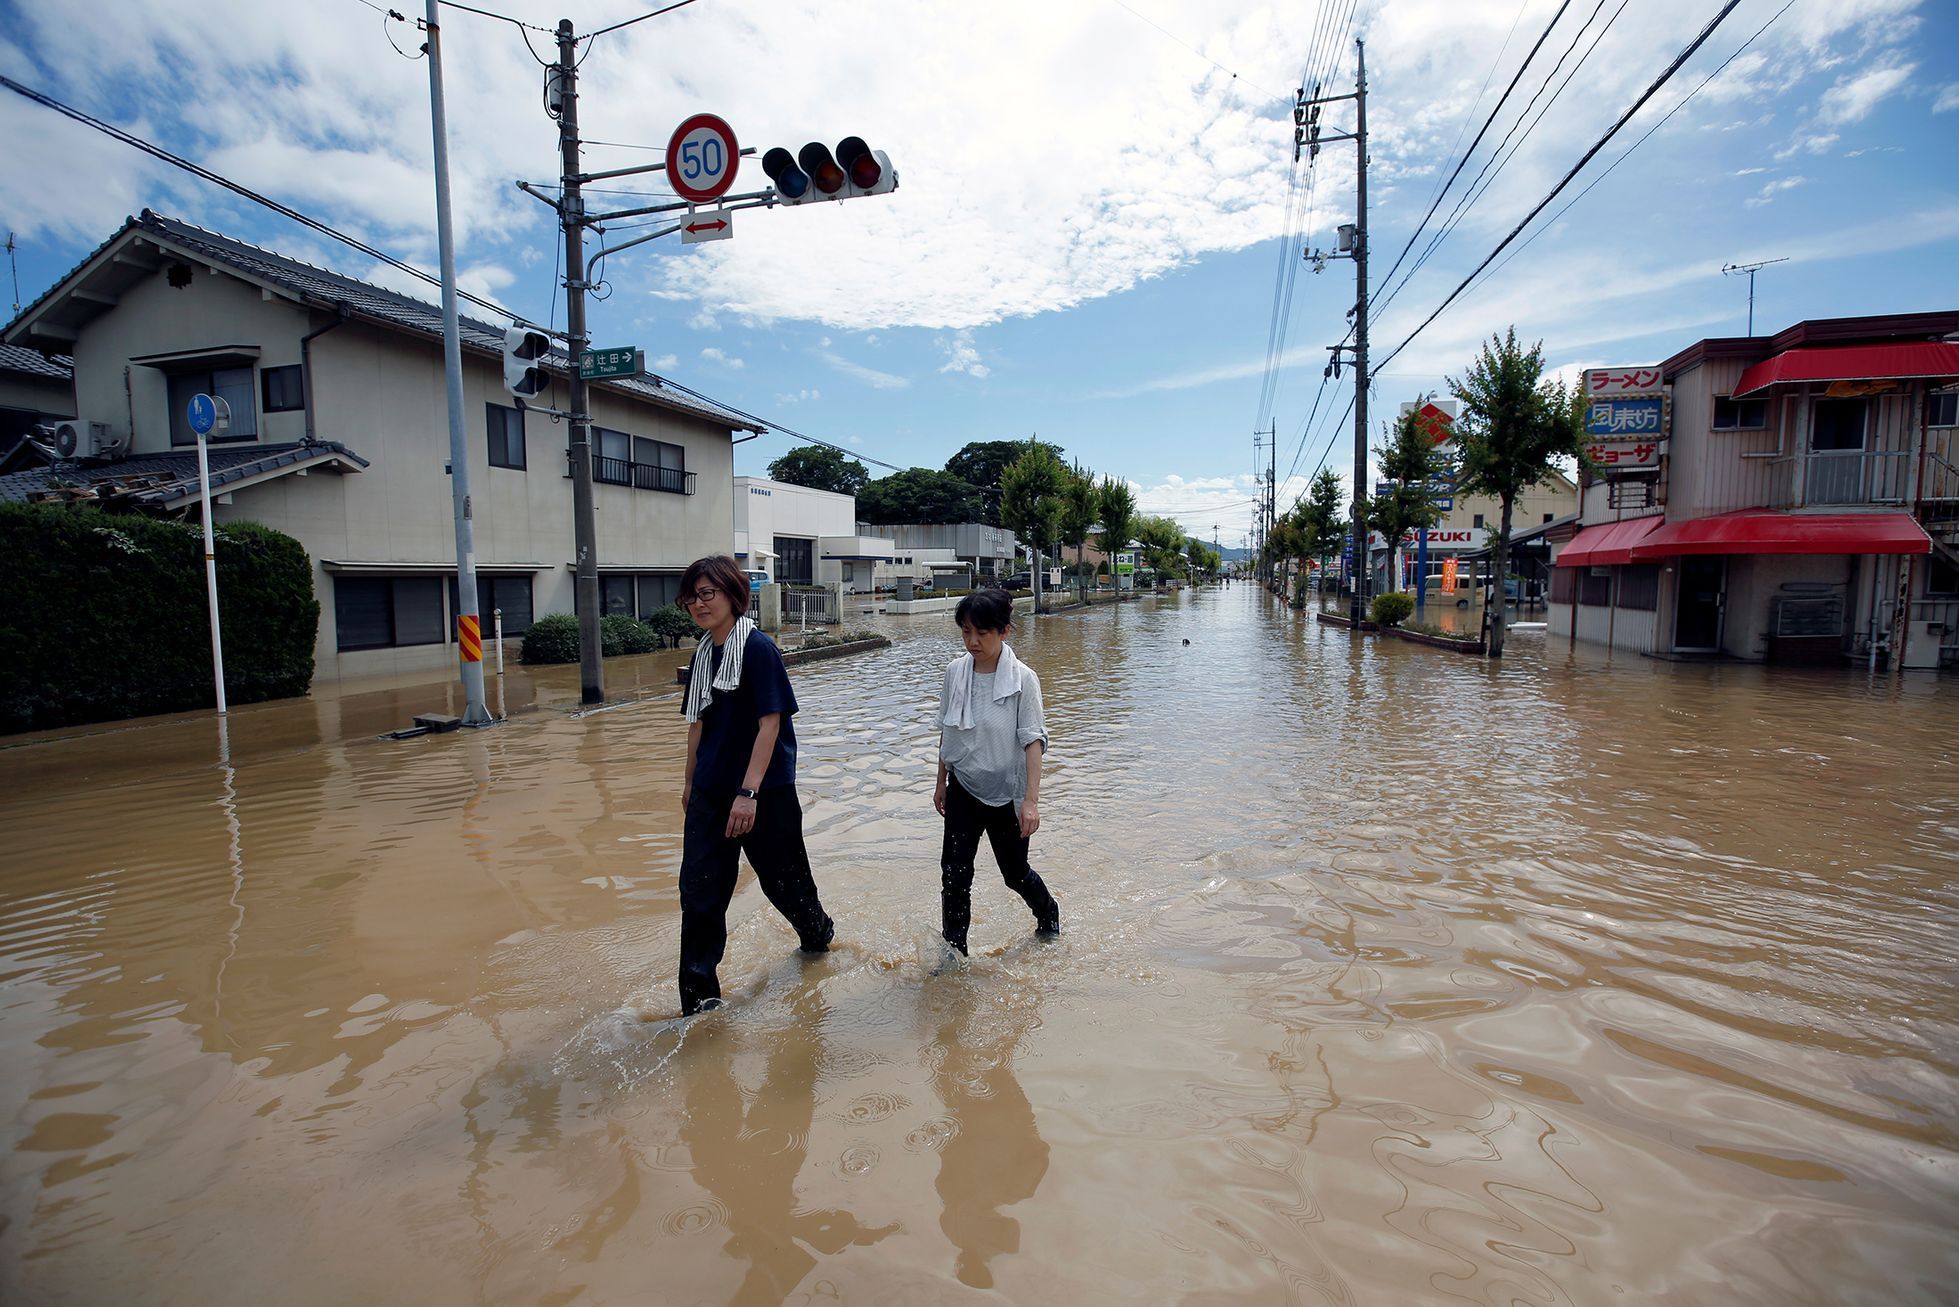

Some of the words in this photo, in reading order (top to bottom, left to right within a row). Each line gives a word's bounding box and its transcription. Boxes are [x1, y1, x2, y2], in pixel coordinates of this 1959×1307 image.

[682, 138, 722, 179] 50
[597, 353, 619, 365] 辻田
[1591, 370, 1660, 390] ラーメン
[1587, 403, 1658, 432] 風来坊
[1586, 443, 1656, 463] ギョーザ
